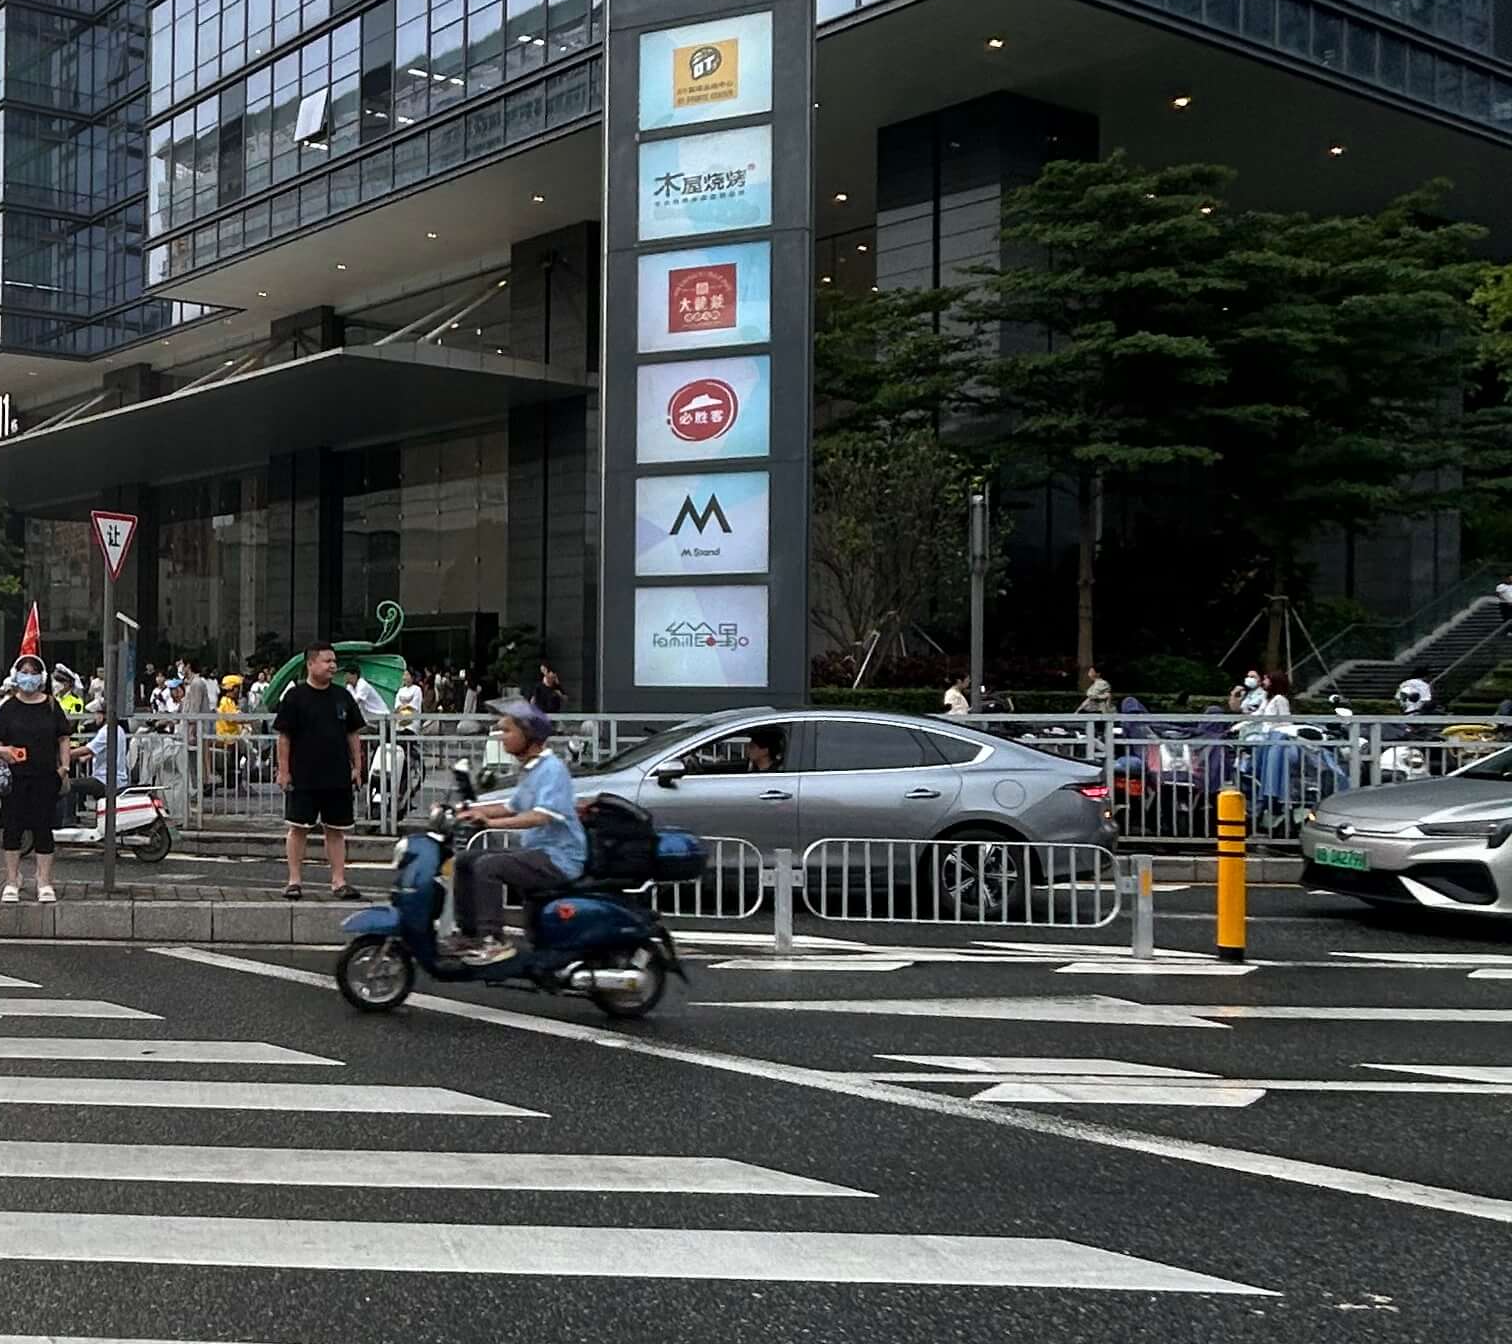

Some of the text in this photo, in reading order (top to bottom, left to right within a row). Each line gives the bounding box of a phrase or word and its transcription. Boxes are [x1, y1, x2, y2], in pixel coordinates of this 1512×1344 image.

[653, 168, 747, 198] 木屋烧烤
[679, 410, 724, 425] 必胜客
[106, 524, 121, 548] 让
